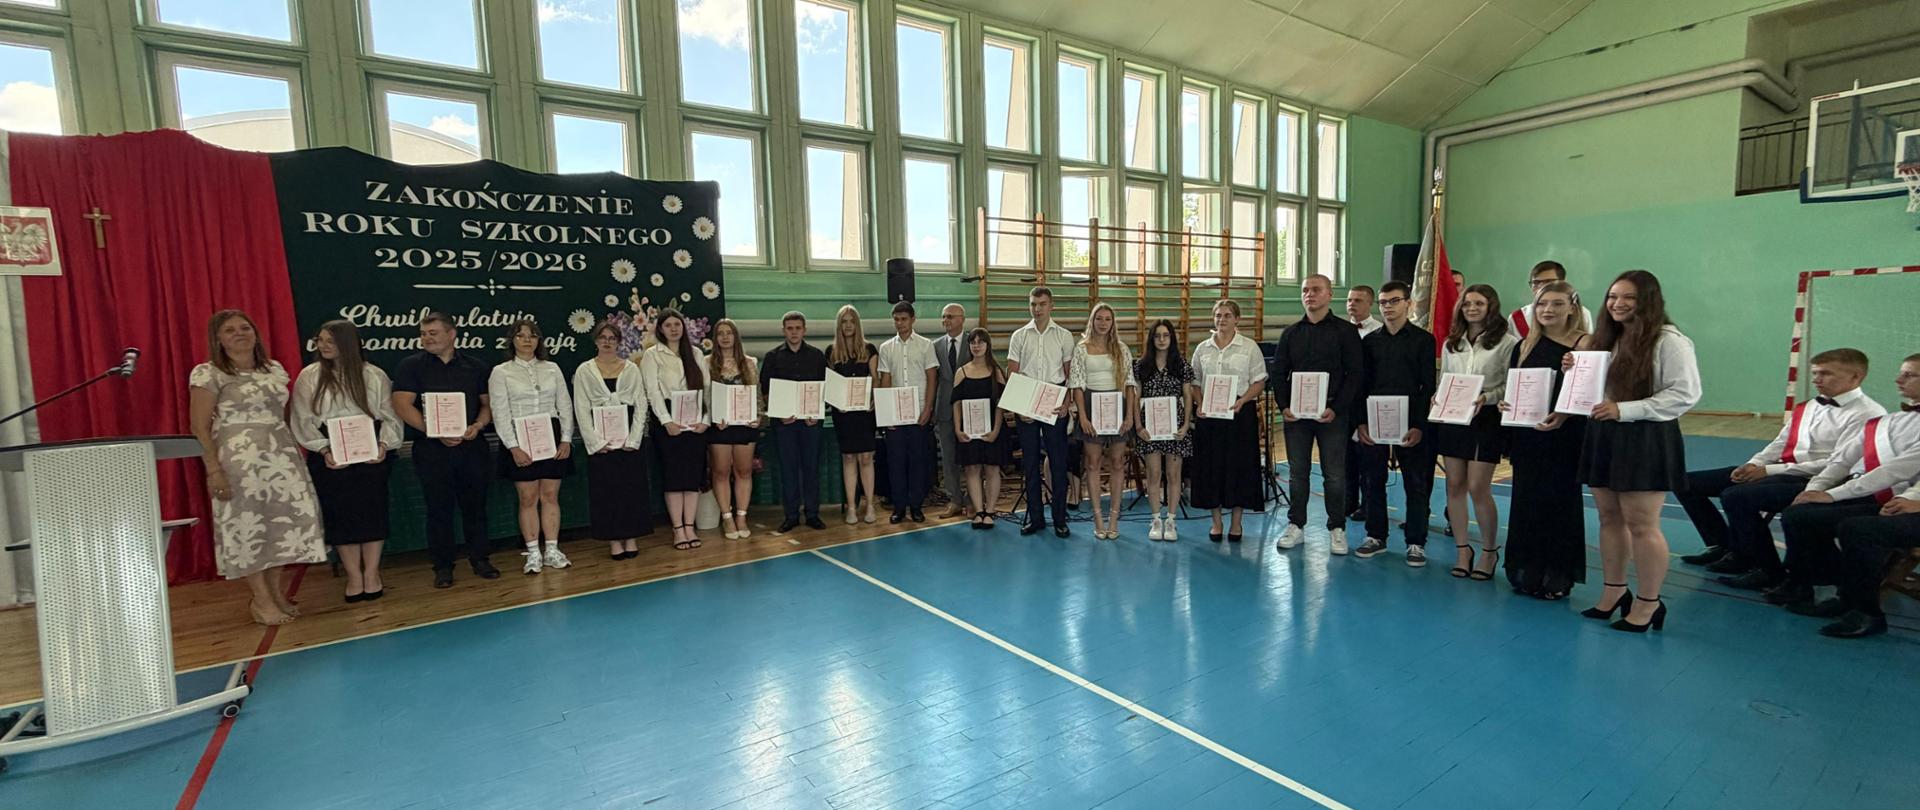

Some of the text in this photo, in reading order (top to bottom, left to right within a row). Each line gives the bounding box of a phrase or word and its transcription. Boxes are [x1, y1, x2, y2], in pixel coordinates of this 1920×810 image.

[301, 211, 673, 246] ROKU SZKOLNEGO
[374, 247, 587, 273] 2025/2026
[339, 304, 432, 328] Chwil
